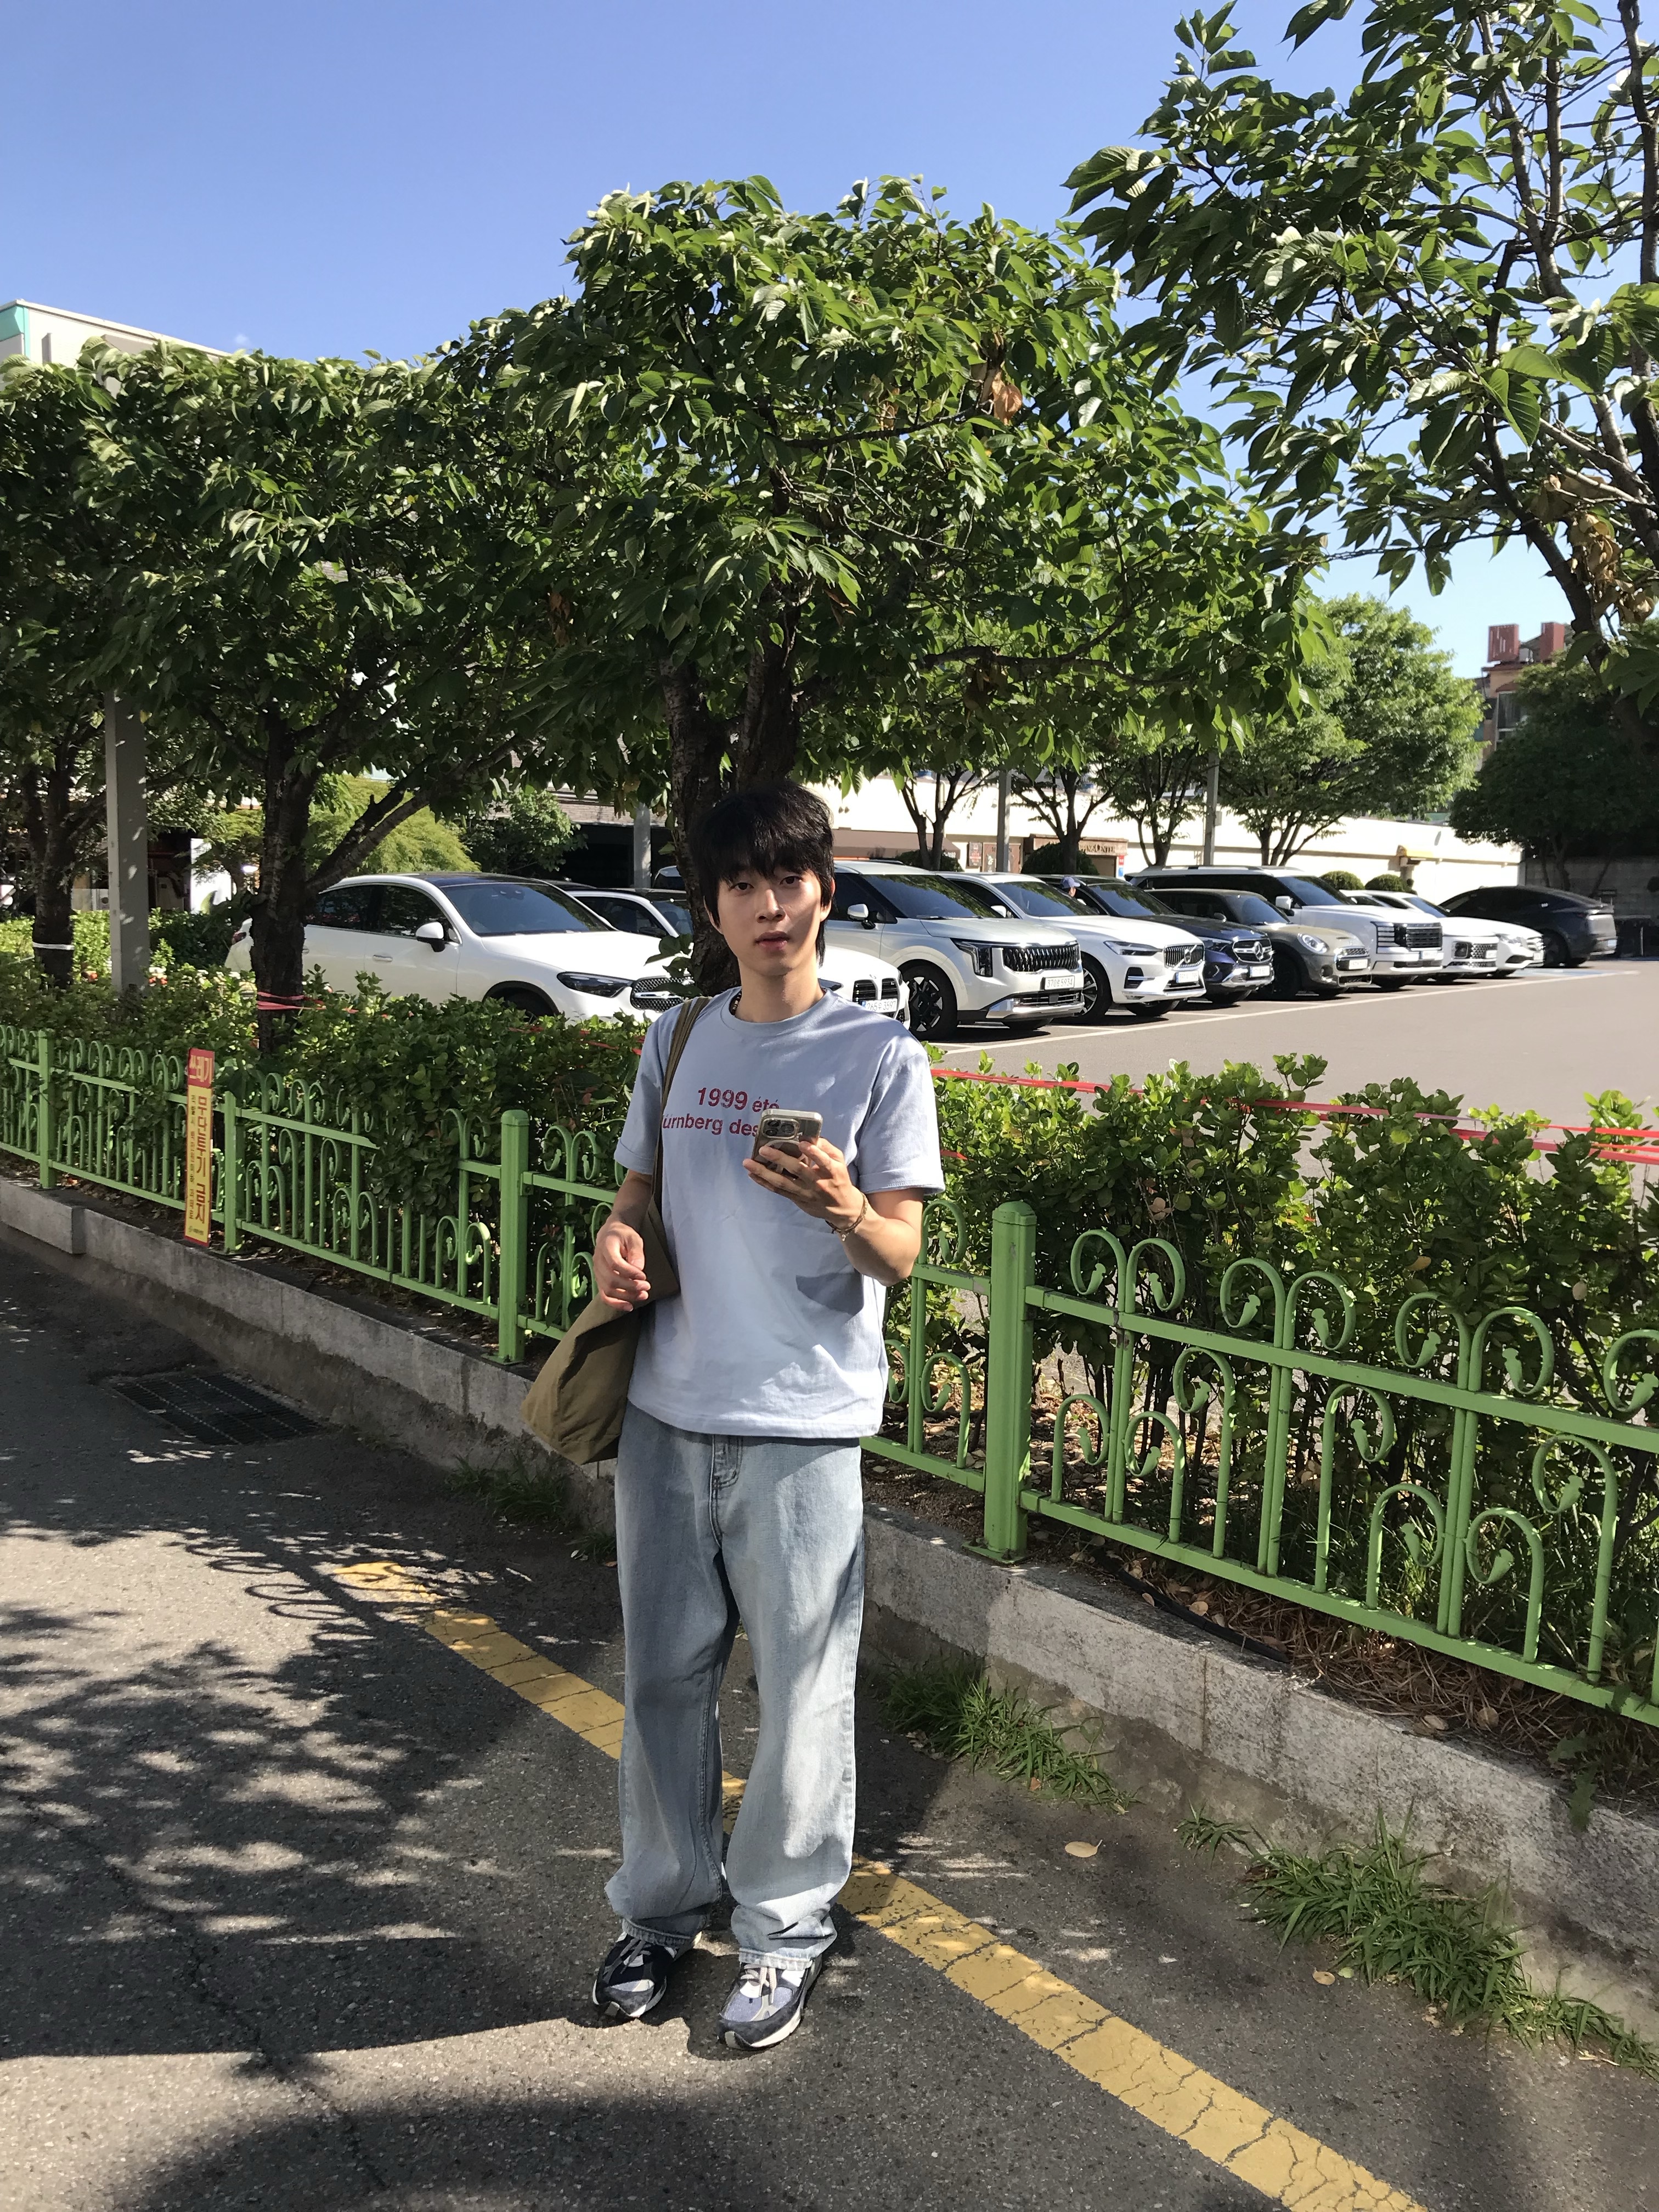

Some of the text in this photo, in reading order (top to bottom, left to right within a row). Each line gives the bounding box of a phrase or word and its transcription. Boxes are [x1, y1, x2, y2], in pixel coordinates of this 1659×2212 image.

[883, 1001, 896, 1010] 3597
[189, 1055, 212, 1084] 쓰레기
[698, 1087, 748, 1110] 1999
[196, 1096, 207, 1177] 무단투기
[663, 1113, 723, 1135] ürnberg
[195, 1183, 206, 1224] 금지
